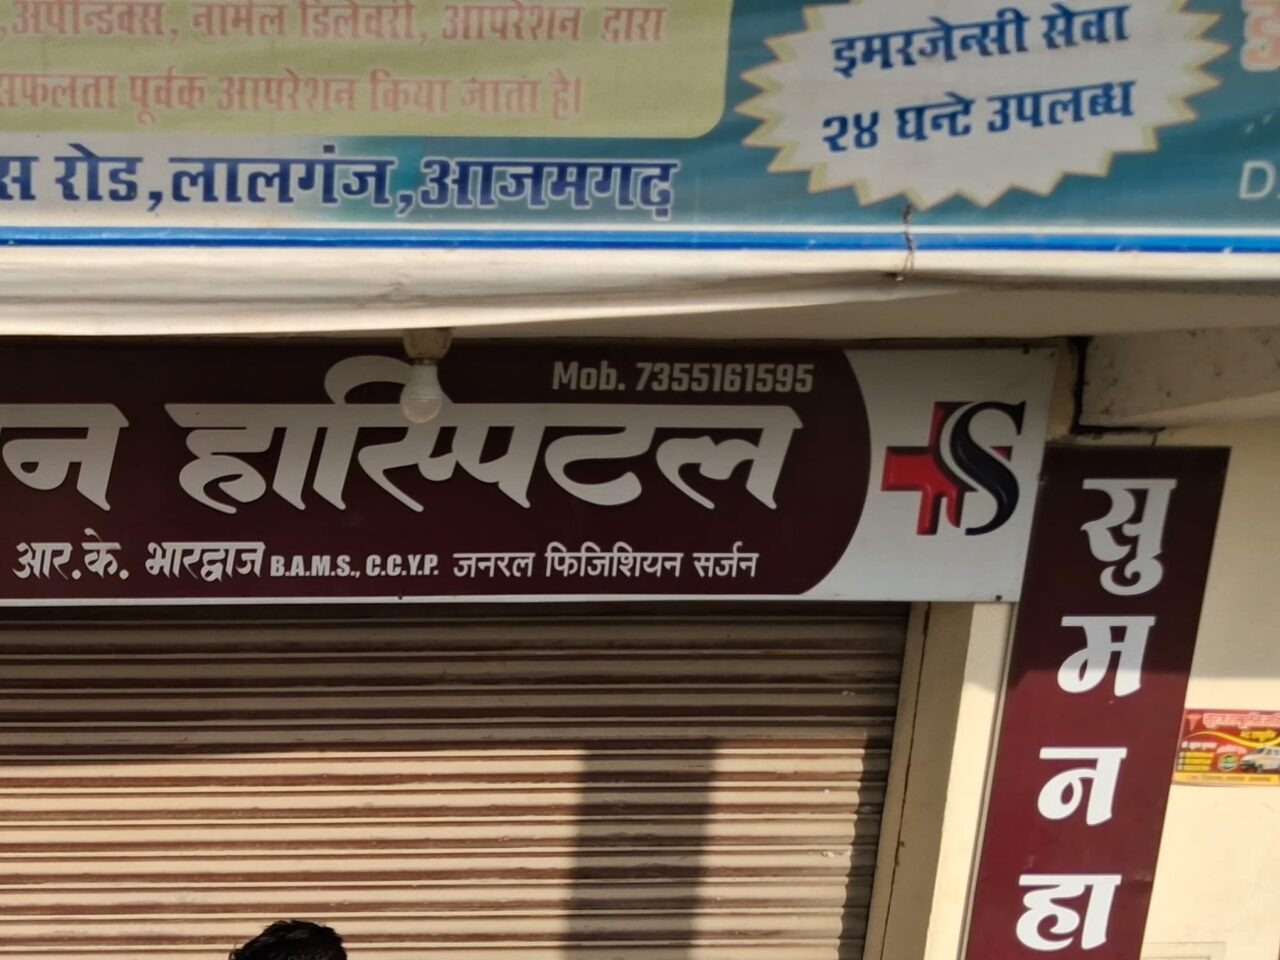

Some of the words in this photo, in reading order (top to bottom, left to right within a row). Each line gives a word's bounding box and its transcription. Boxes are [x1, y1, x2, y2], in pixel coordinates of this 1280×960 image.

[1042, 4, 1132, 50] सेवा
[369, 69, 451, 115] किया
[552, 361, 626, 391] Mob.
[634, 362, 815, 394] 7355161595
[144, 541, 266, 582] भारद्वाज
[365, 554, 440, 578] C.C.Y.P.
[453, 552, 534, 579] जनरल
[545, 542, 683, 579] फिजिशियन
[692, 541, 760, 579] सर्जन
